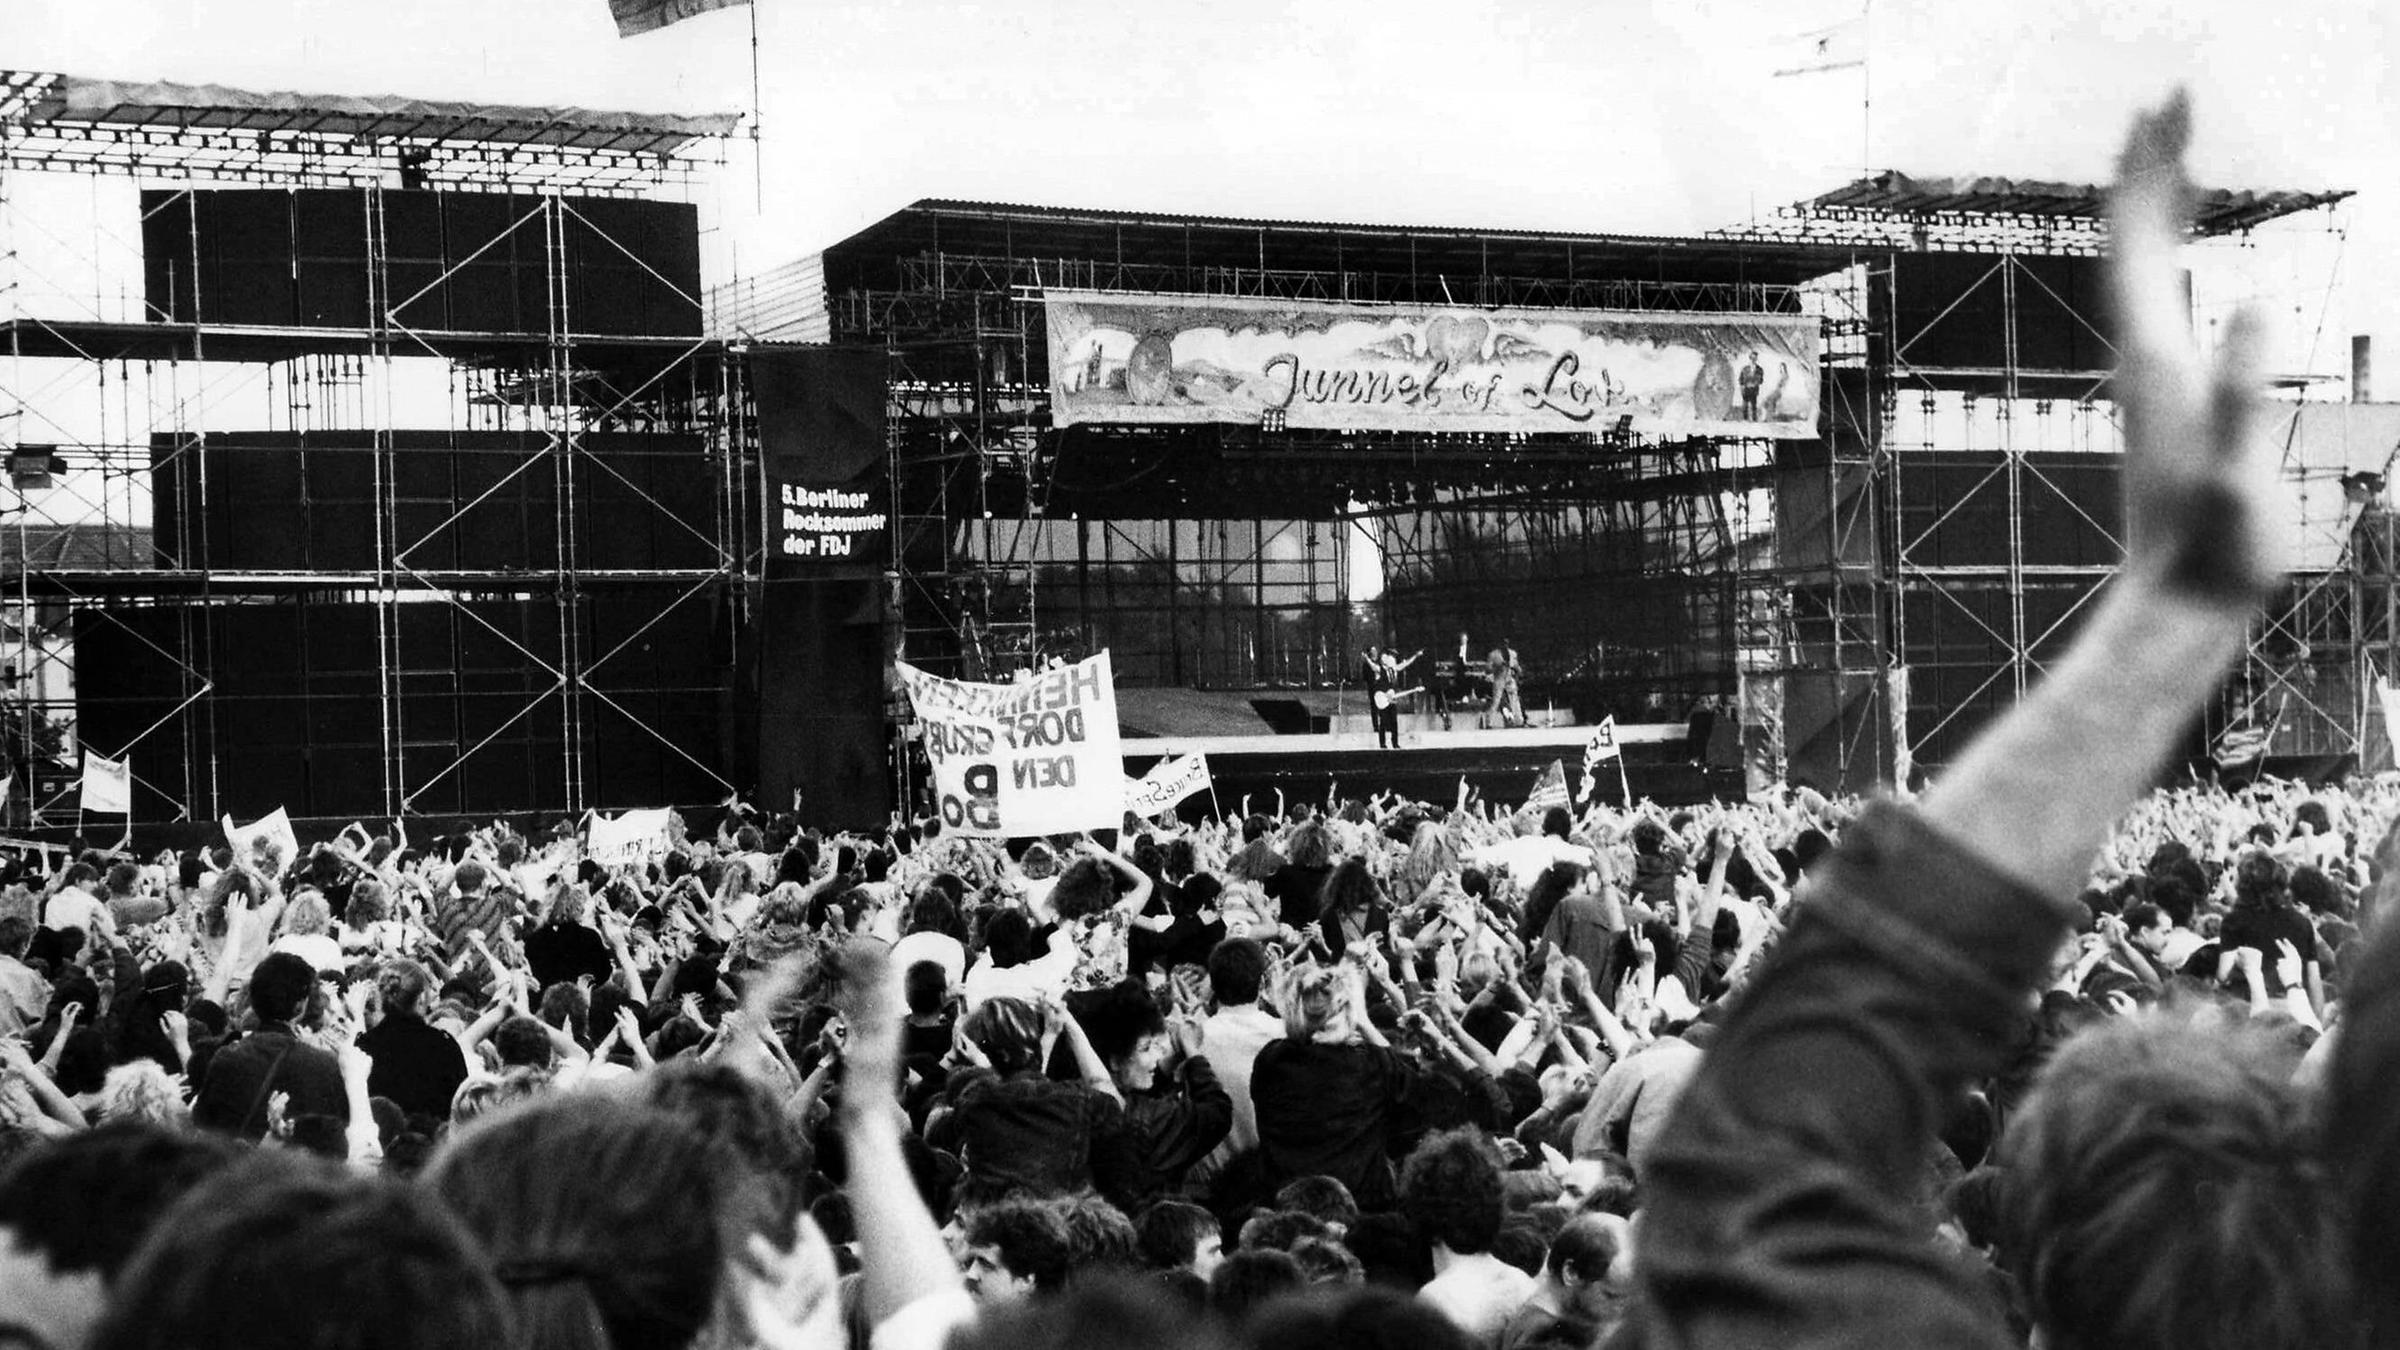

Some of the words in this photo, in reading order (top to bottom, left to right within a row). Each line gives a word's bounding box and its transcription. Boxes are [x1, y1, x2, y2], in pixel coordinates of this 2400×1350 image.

[1262, 352, 1449, 409] Tunnel
[1461, 373, 1503, 412] of
[783, 508, 887, 532] Rocksommer
[783, 533, 816, 555] der
[820, 534, 851, 556] FDJ
